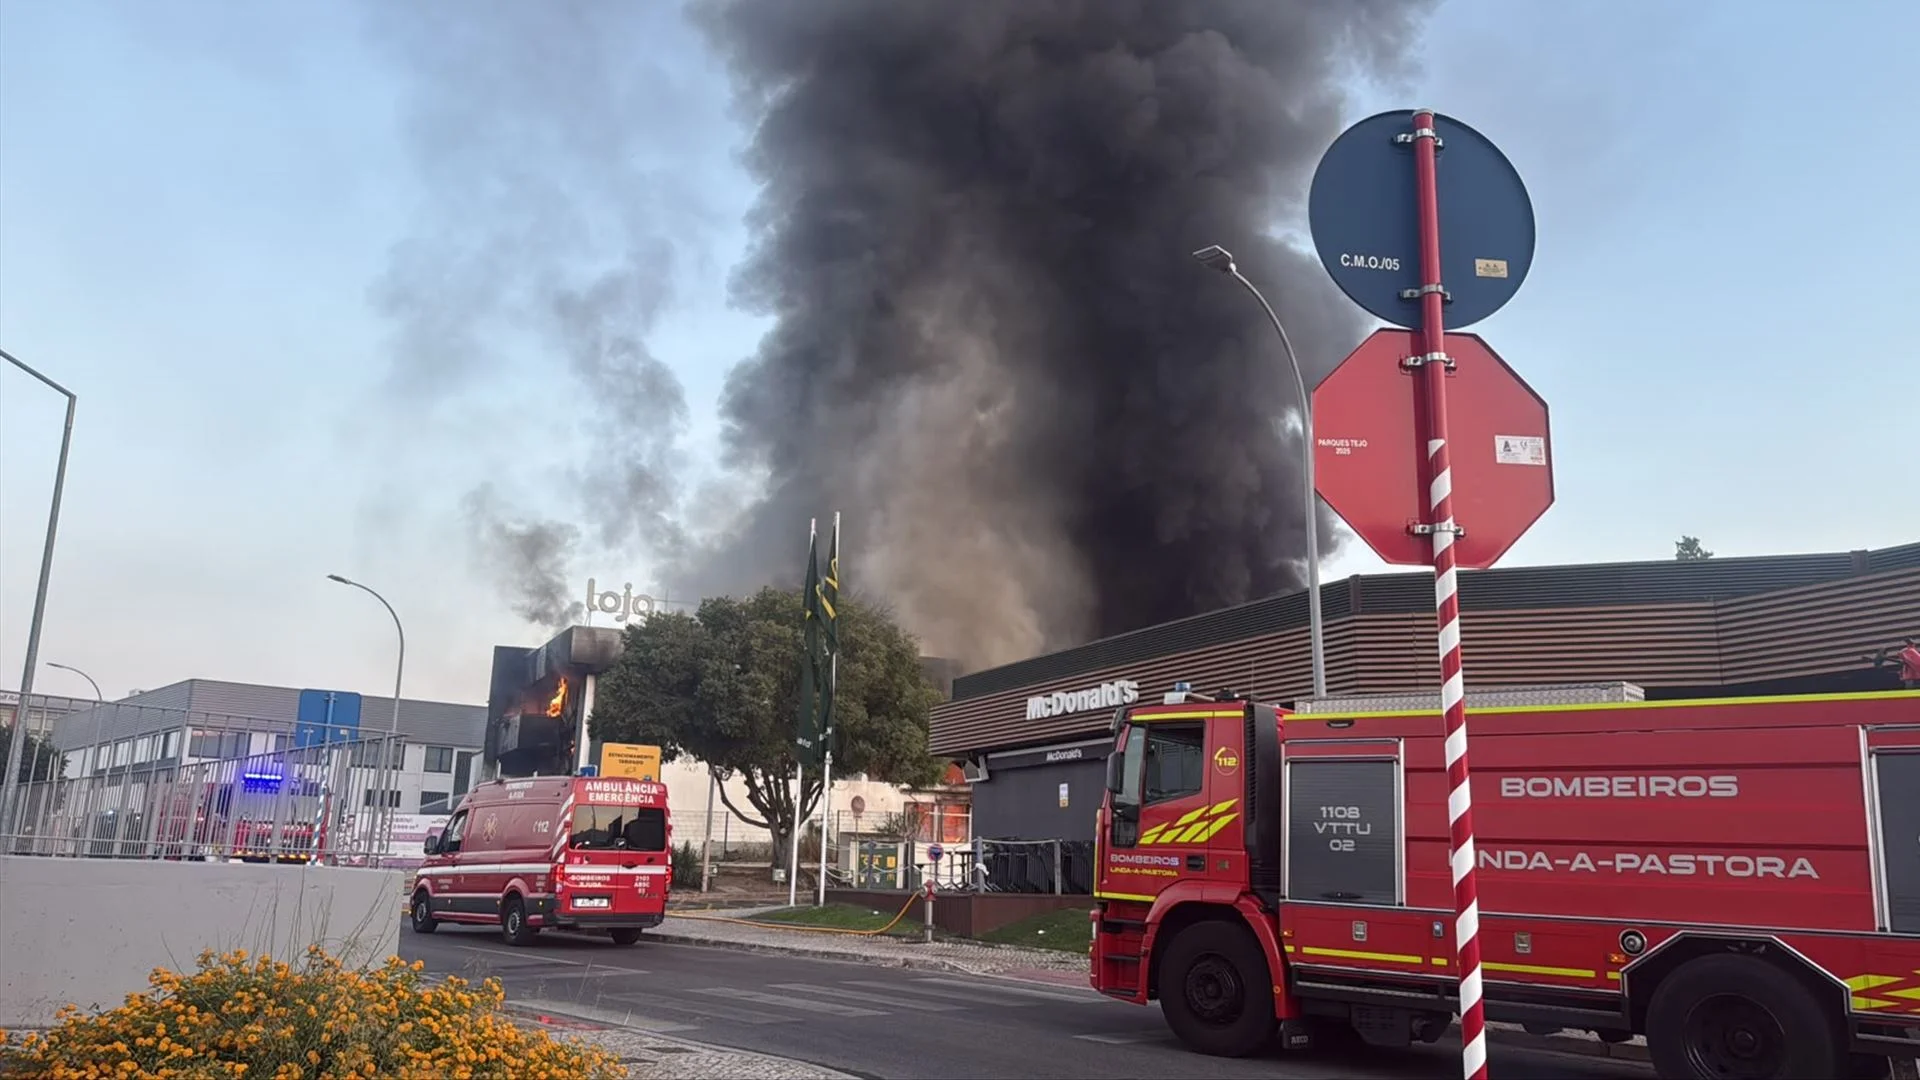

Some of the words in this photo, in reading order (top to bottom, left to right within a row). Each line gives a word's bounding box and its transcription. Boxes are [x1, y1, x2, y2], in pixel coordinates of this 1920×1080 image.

[1340, 253, 1400, 271] C.M.O./05
[1317, 438, 1350, 447] PARQUES
[1351, 439, 1368, 448] TEJO
[1046, 748, 1082, 761] McDonald's
[1217, 756, 1237, 767] 112
[585, 781, 658, 795] AMBULÂNCIA
[1500, 775, 1738, 797] BOMBEIROS
[588, 792, 655, 804] EMERGÊNCIA
[1320, 806, 1360, 818] 1108
[538, 819, 550, 833] 112
[1313, 822, 1371, 835] VTTU
[1329, 839, 1356, 851] 02
[1110, 853, 1180, 866] BOMBEIROS
[1449, 848, 1820, 880] NDA-A-PASTORA
[570, 874, 611, 882] BOMBEIROS
[1110, 866, 1179, 877] LINDA-A-PASTORA
